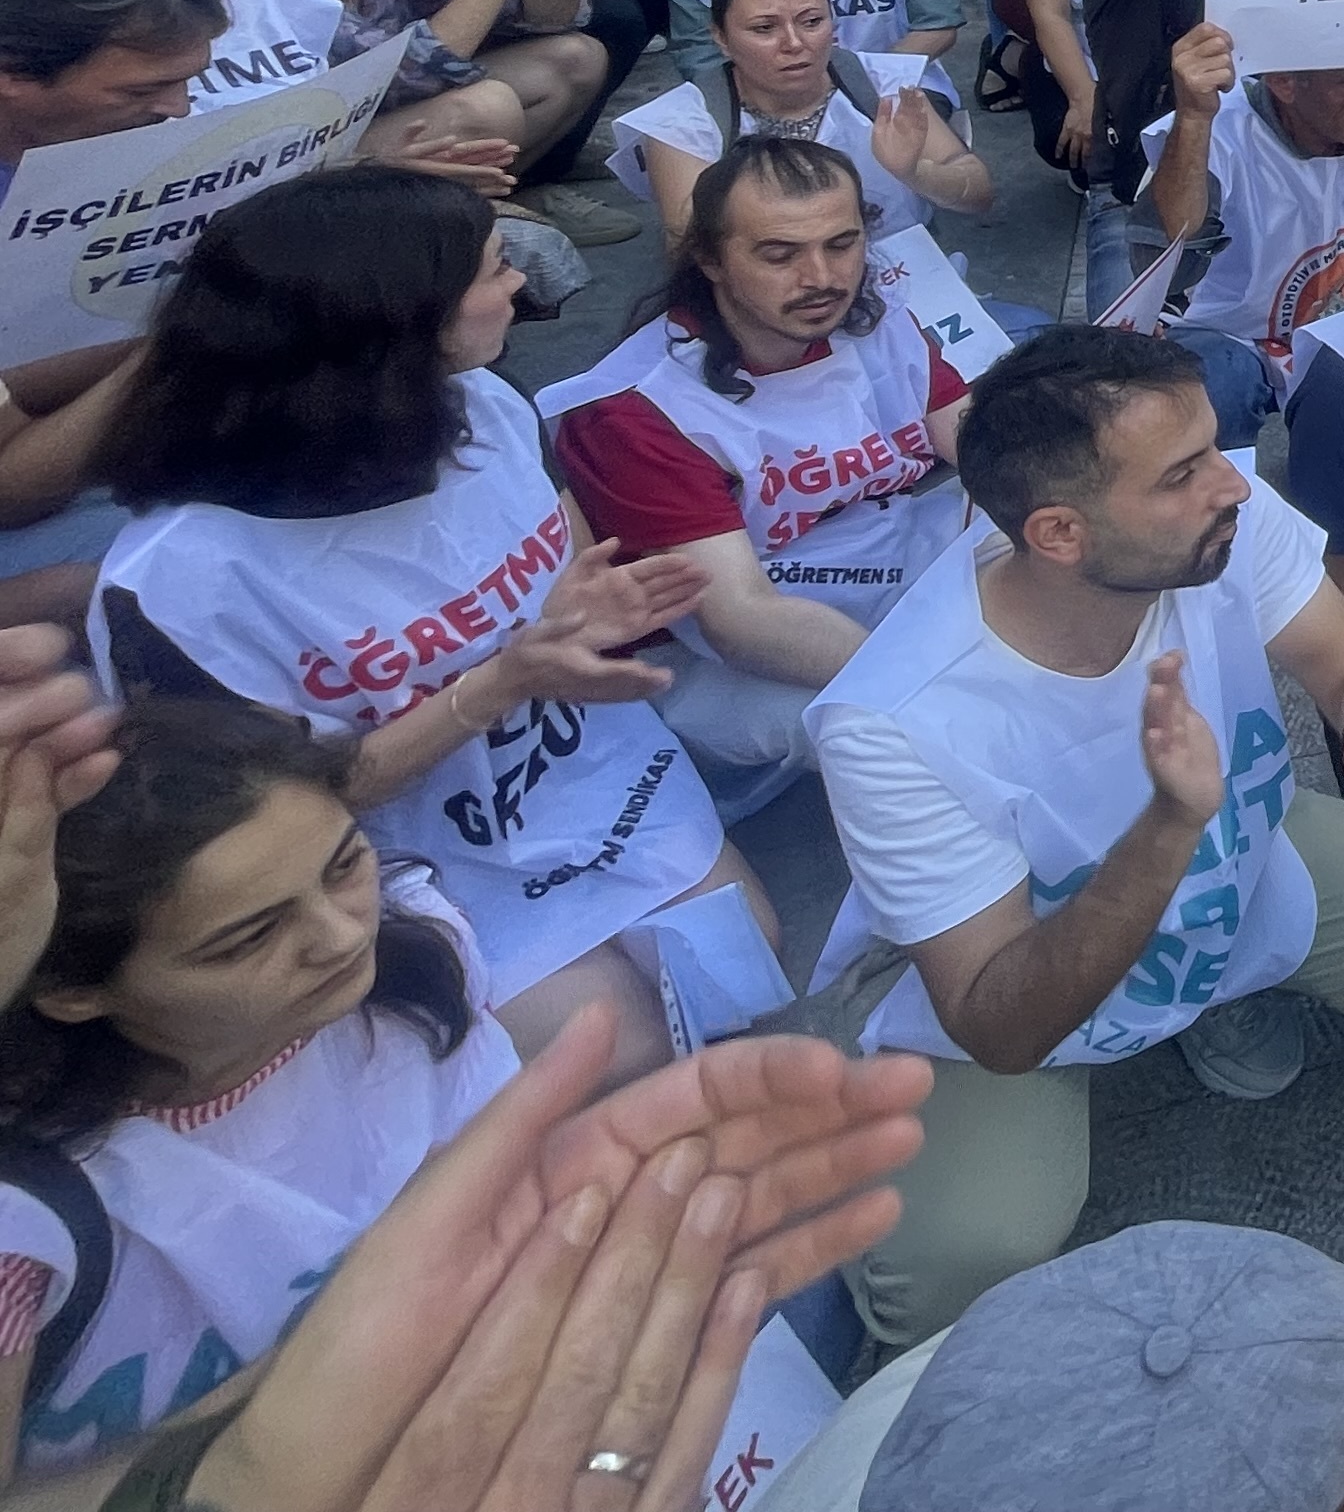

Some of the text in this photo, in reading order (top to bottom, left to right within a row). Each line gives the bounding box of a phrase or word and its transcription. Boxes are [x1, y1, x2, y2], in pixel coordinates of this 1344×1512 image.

[9, 155, 266, 240] İŞÇİLERİN
[766, 561, 884, 585] ÖĞRETMEN
[611, 749, 678, 840] SENDİKASI
